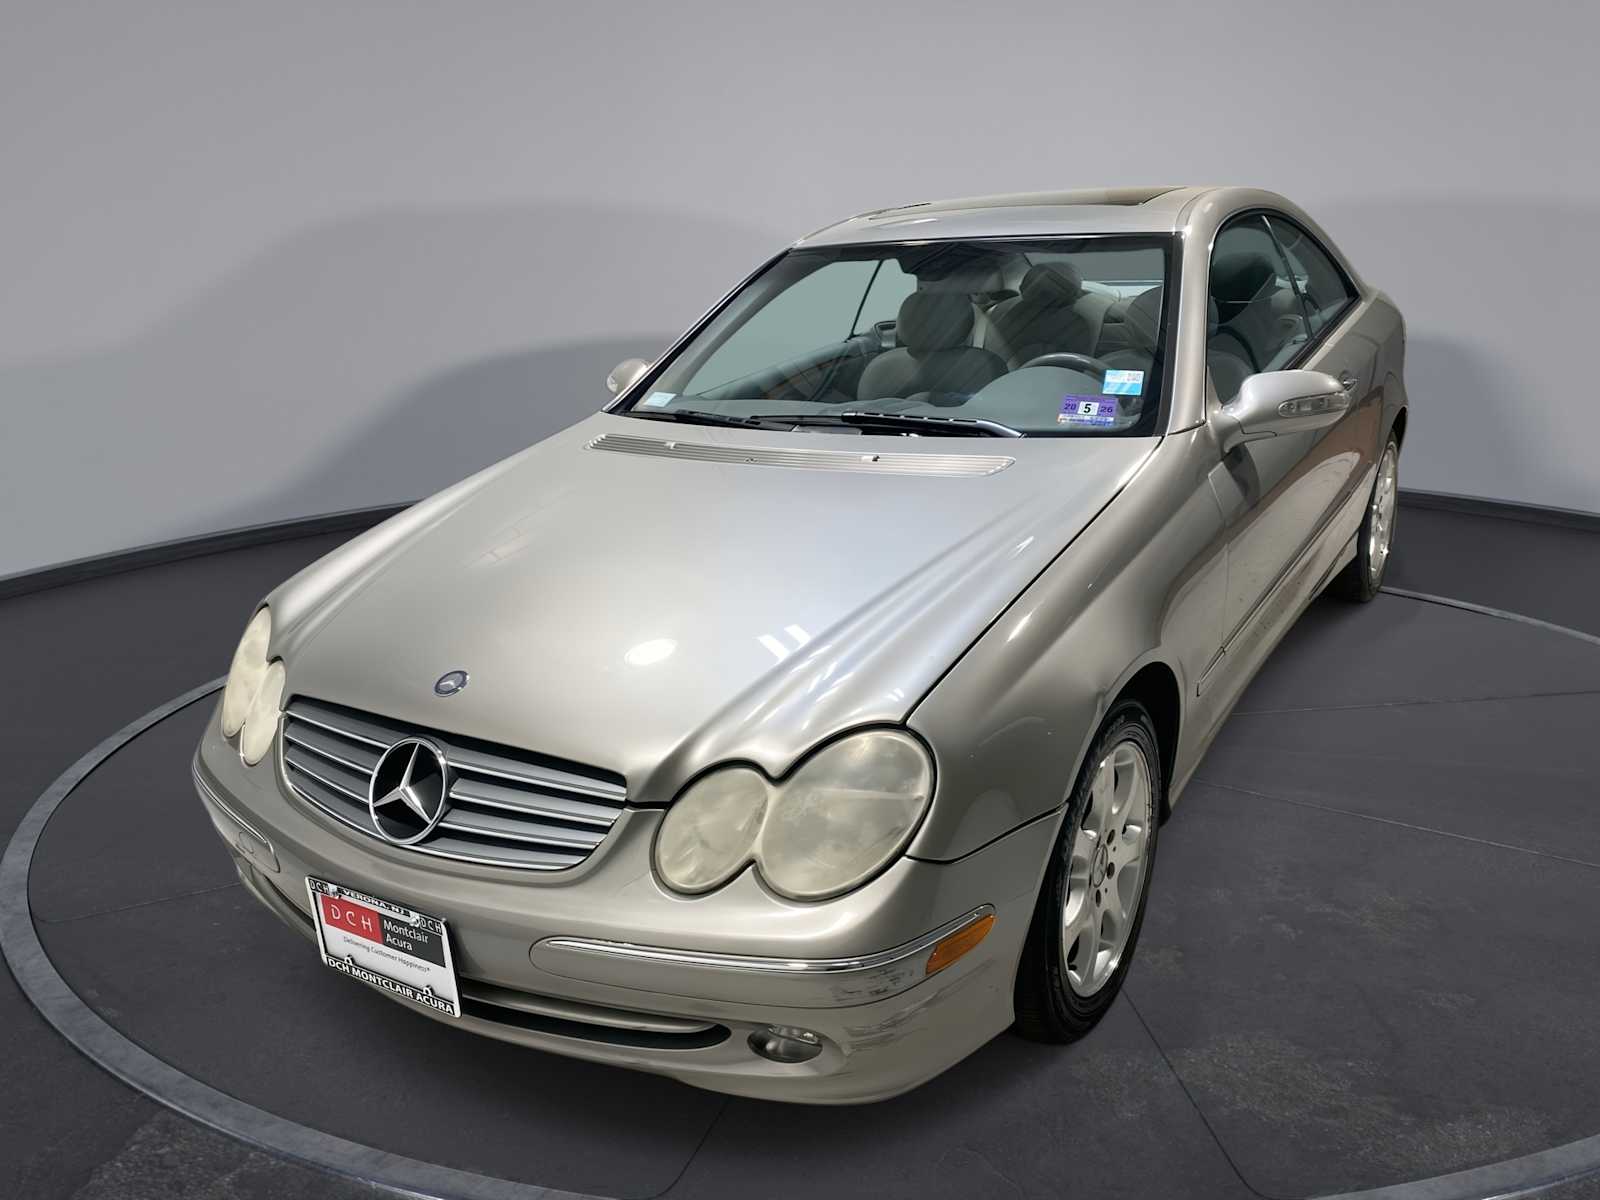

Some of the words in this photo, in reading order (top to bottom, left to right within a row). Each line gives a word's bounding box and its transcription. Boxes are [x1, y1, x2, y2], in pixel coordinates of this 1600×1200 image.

[1083, 403, 1092, 414] 5
[1101, 406, 1113, 414] 26
[309, 879, 329, 893] DCH
[383, 919, 429, 944] Montclair
[420, 917, 442, 934] DCH
[386, 933, 413, 951] Acura
[328, 958, 350, 973] DCH
[351, 968, 414, 998] MONTCLAIR
[415, 993, 454, 1015] ACURA
